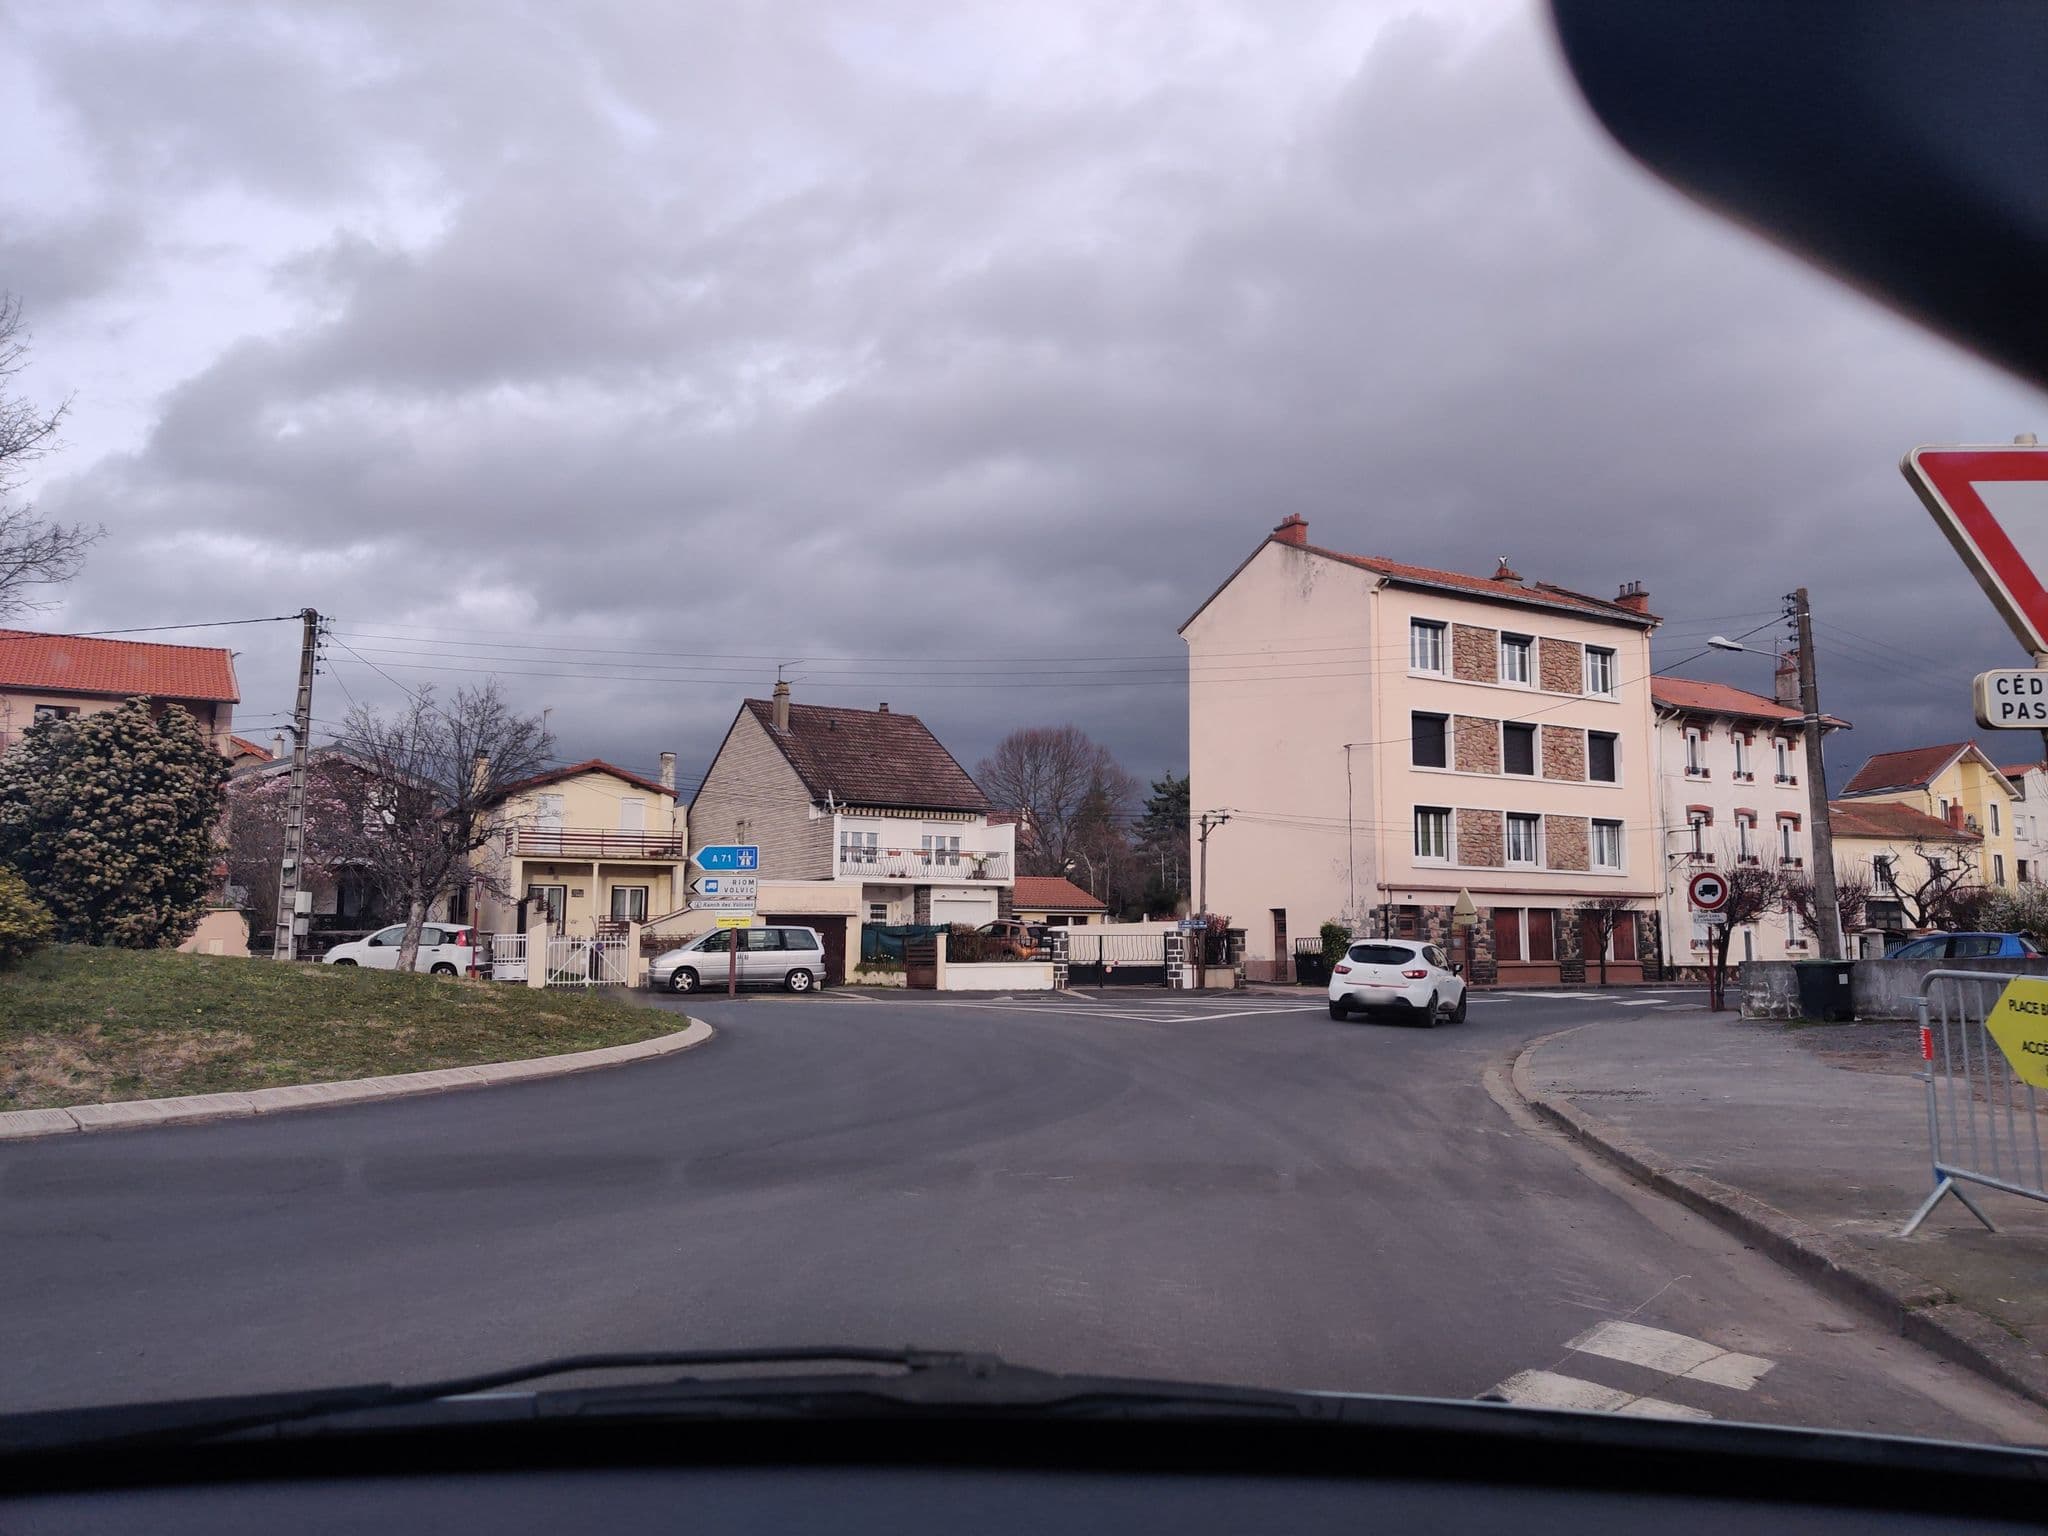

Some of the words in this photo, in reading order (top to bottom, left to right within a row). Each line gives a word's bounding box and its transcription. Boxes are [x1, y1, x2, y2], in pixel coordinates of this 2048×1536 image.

[1996, 673, 2043, 696] CÉD
[2001, 701, 2047, 720] PAS
[712, 854, 718, 863] A
[720, 854, 732, 863] 71
[2007, 998, 2039, 1015] PLACE
